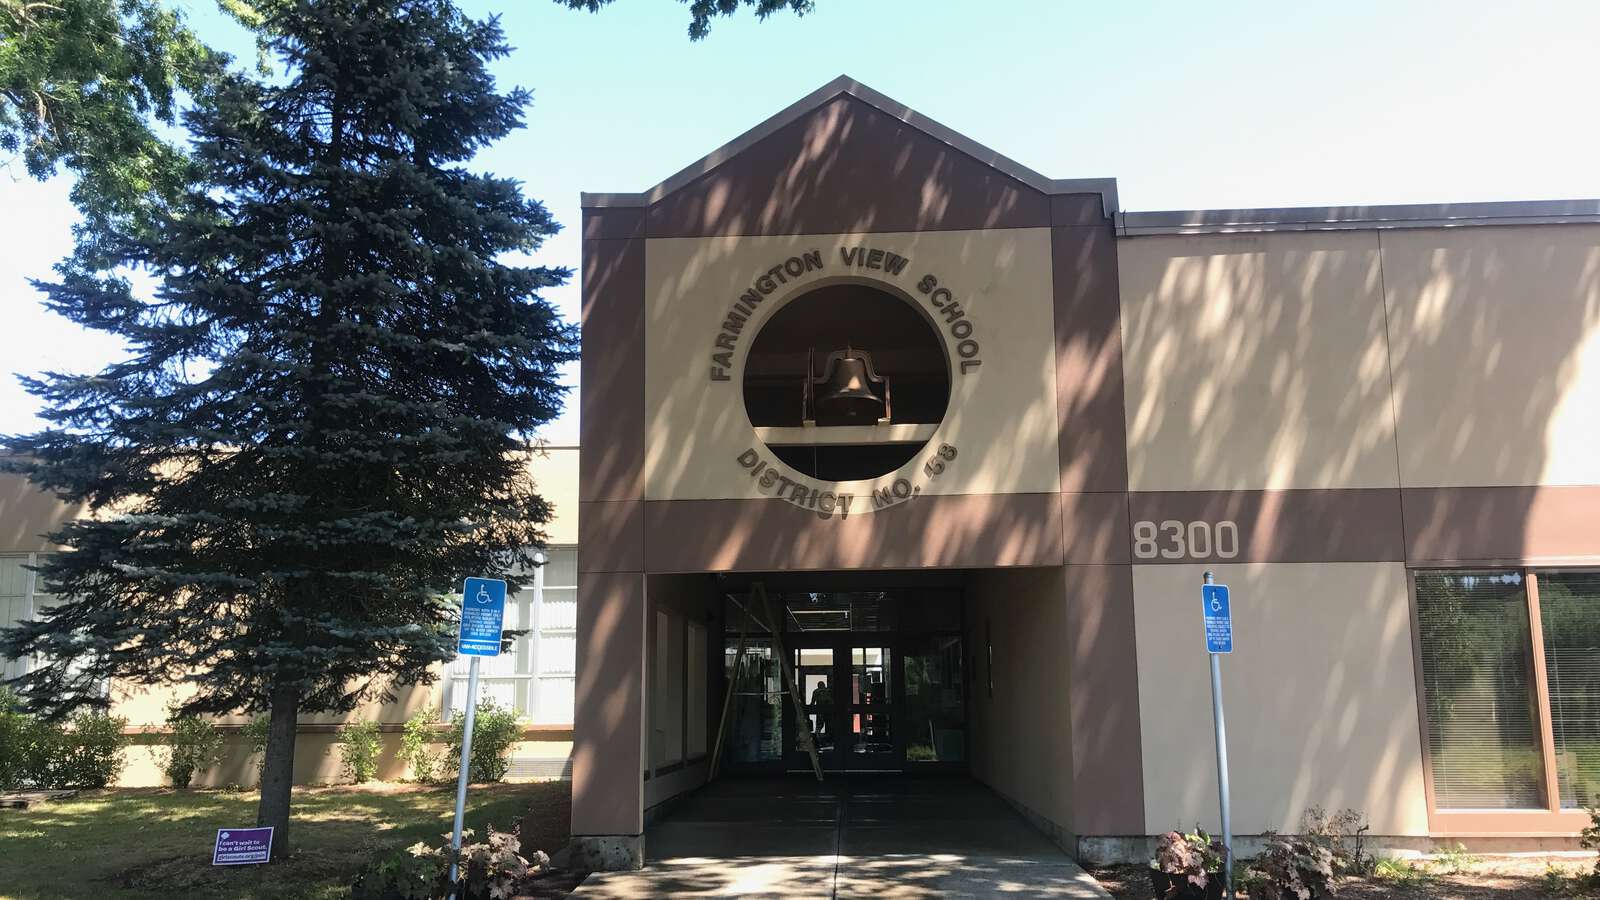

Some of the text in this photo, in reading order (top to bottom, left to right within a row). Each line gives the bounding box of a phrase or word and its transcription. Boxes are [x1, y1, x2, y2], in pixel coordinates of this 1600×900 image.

[711, 247, 982, 381] FARMINGTON VIEW SCHOOL
[737, 448, 854, 514] DISTRICT
[1133, 520, 1239, 559] 8300
